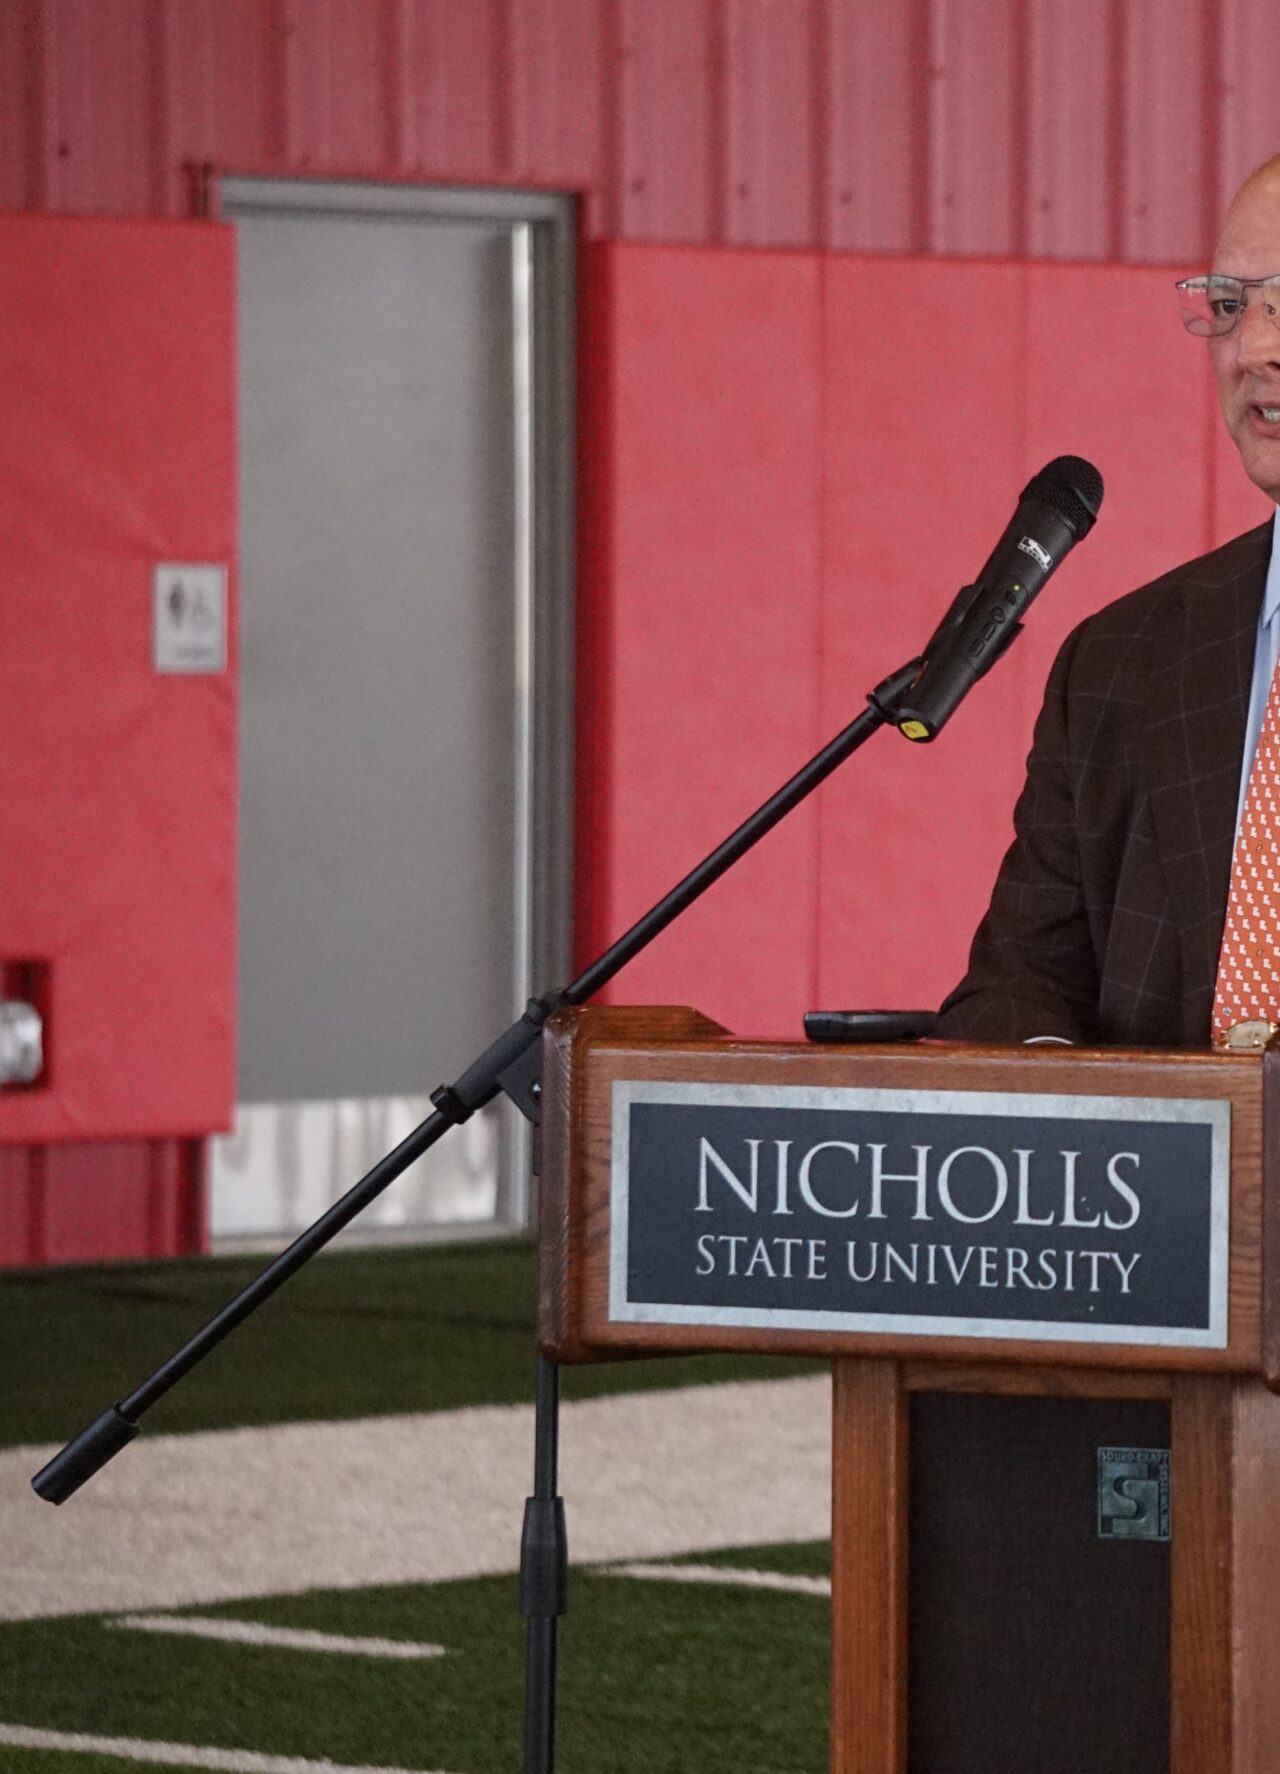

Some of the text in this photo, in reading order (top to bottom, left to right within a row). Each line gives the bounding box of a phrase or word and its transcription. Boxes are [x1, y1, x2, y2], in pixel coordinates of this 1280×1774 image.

[694, 1136, 1142, 1230] NICHOLLS
[695, 1234, 1142, 1294] STATE UNIVERSITY
